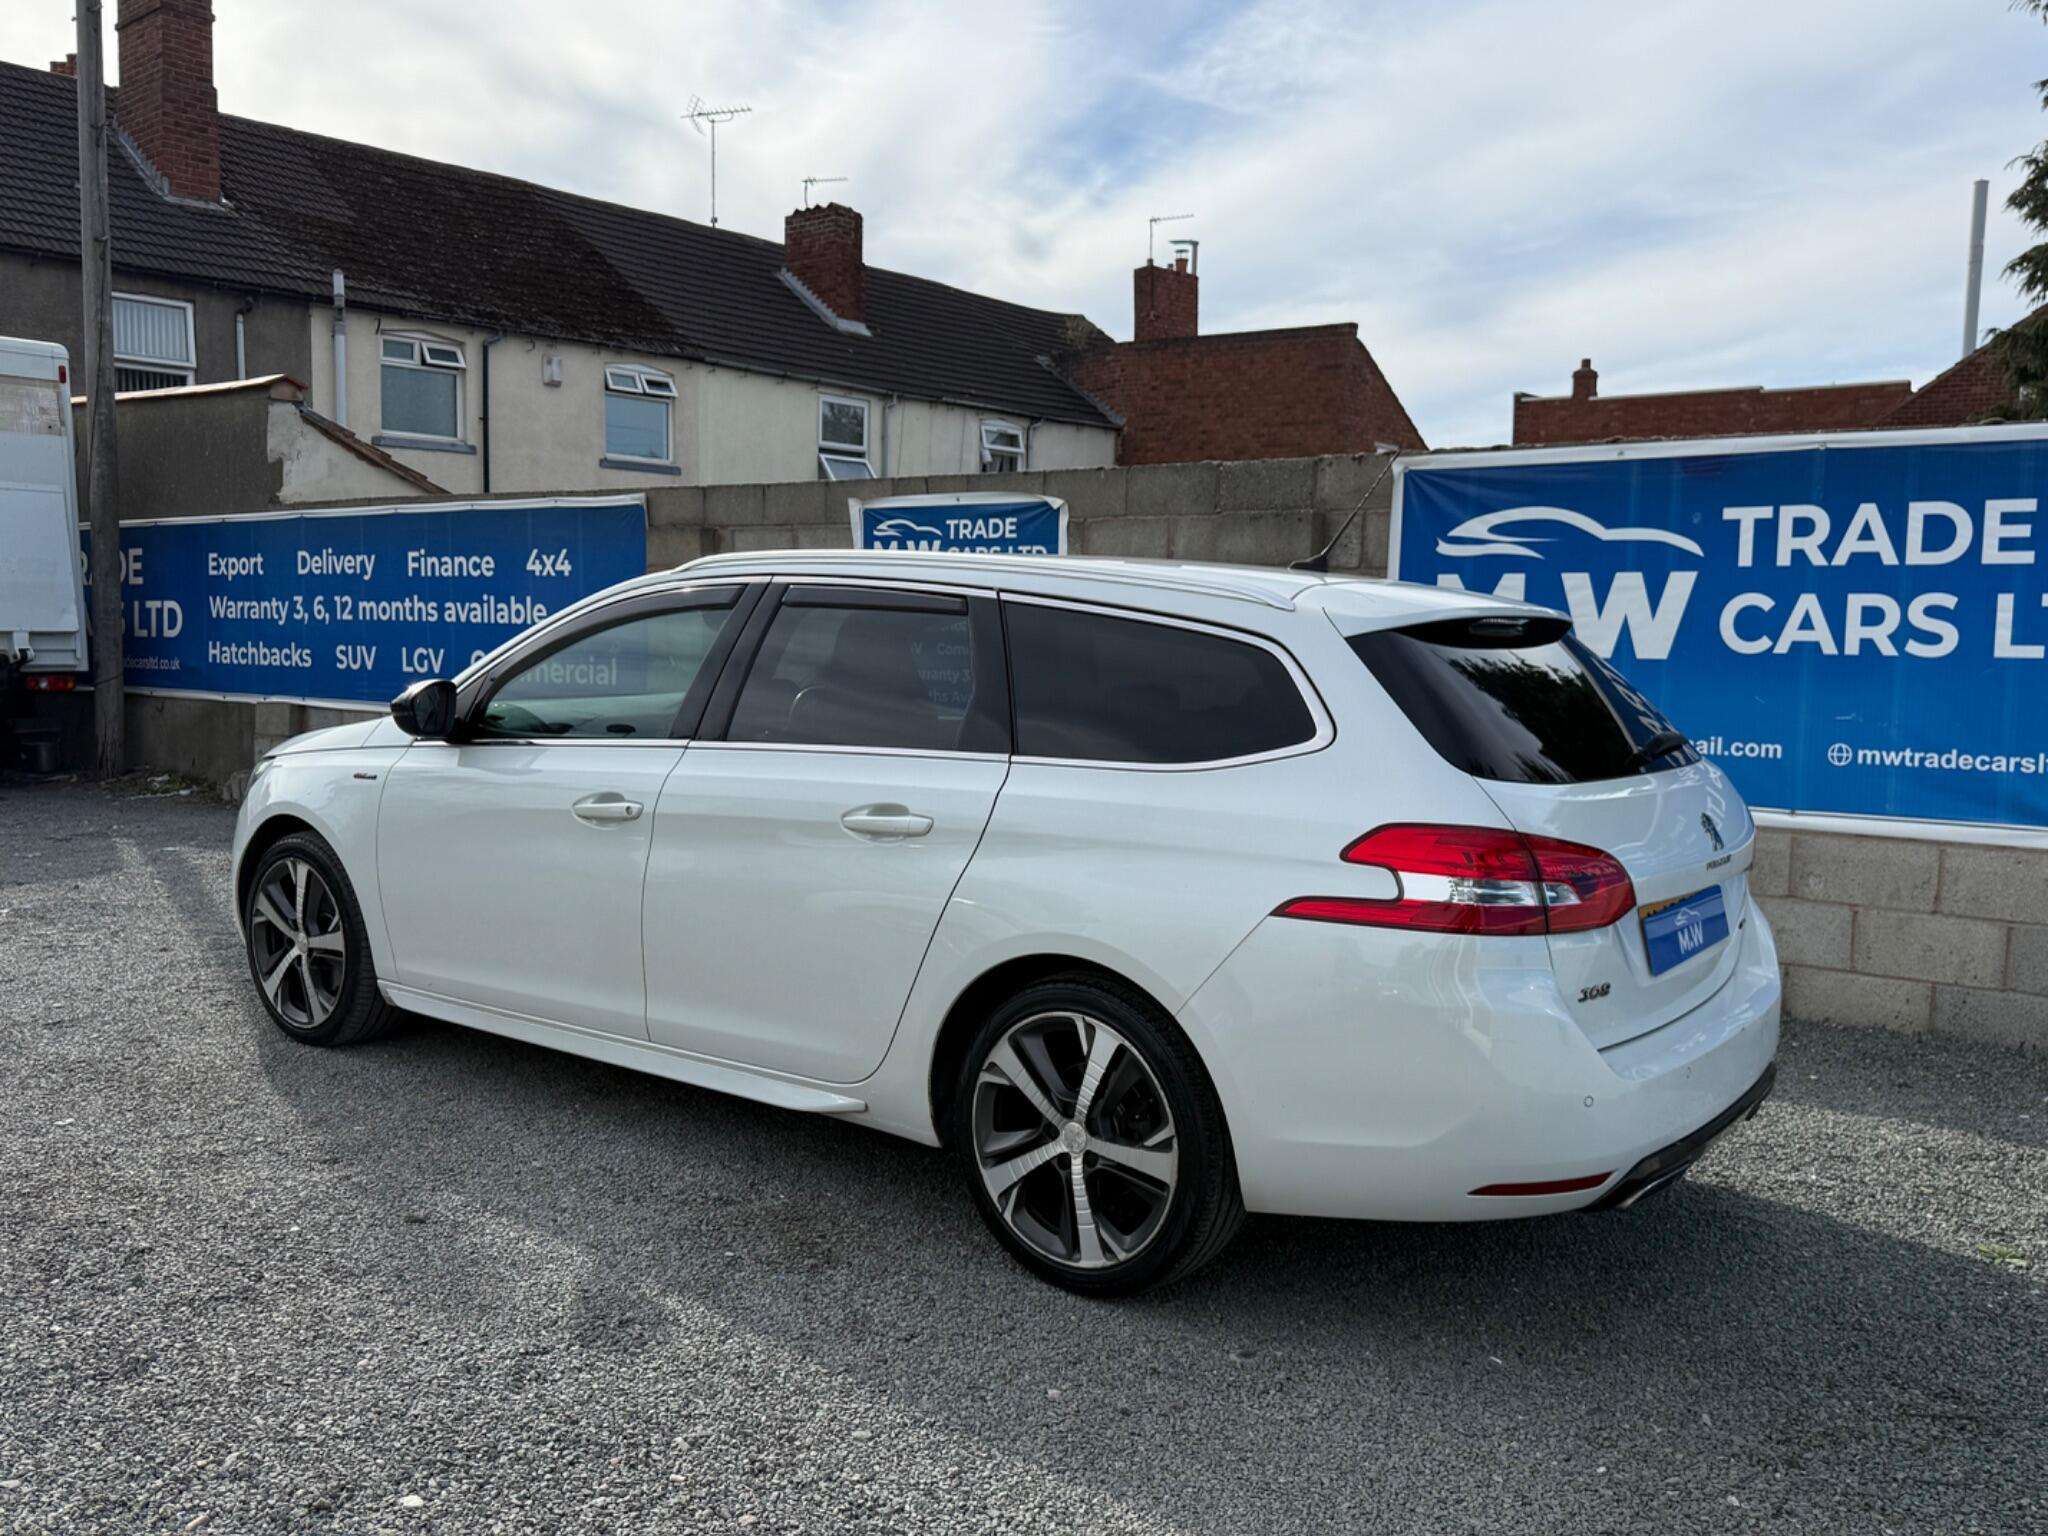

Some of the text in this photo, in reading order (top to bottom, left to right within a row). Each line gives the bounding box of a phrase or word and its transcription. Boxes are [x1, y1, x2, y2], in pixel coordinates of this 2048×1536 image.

[945, 517, 1018, 540] TRADE
[1722, 498, 2038, 568] TRADE
[208, 548, 572, 581] Export Delivery Finance 4x4
[133, 600, 184, 638] LTD
[208, 594, 548, 626] Warranty 3, 6, 12 months available
[1719, 592, 2048, 659] CARS L
[208, 641, 312, 668] Hatchbacks
[335, 645, 377, 671] SUV
[401, 647, 445, 674] LGV
[1688, 736, 1783, 760] ail.com
[1857, 746, 2048, 775] mwtradecarsl
[1577, 981, 1611, 1003] 308
